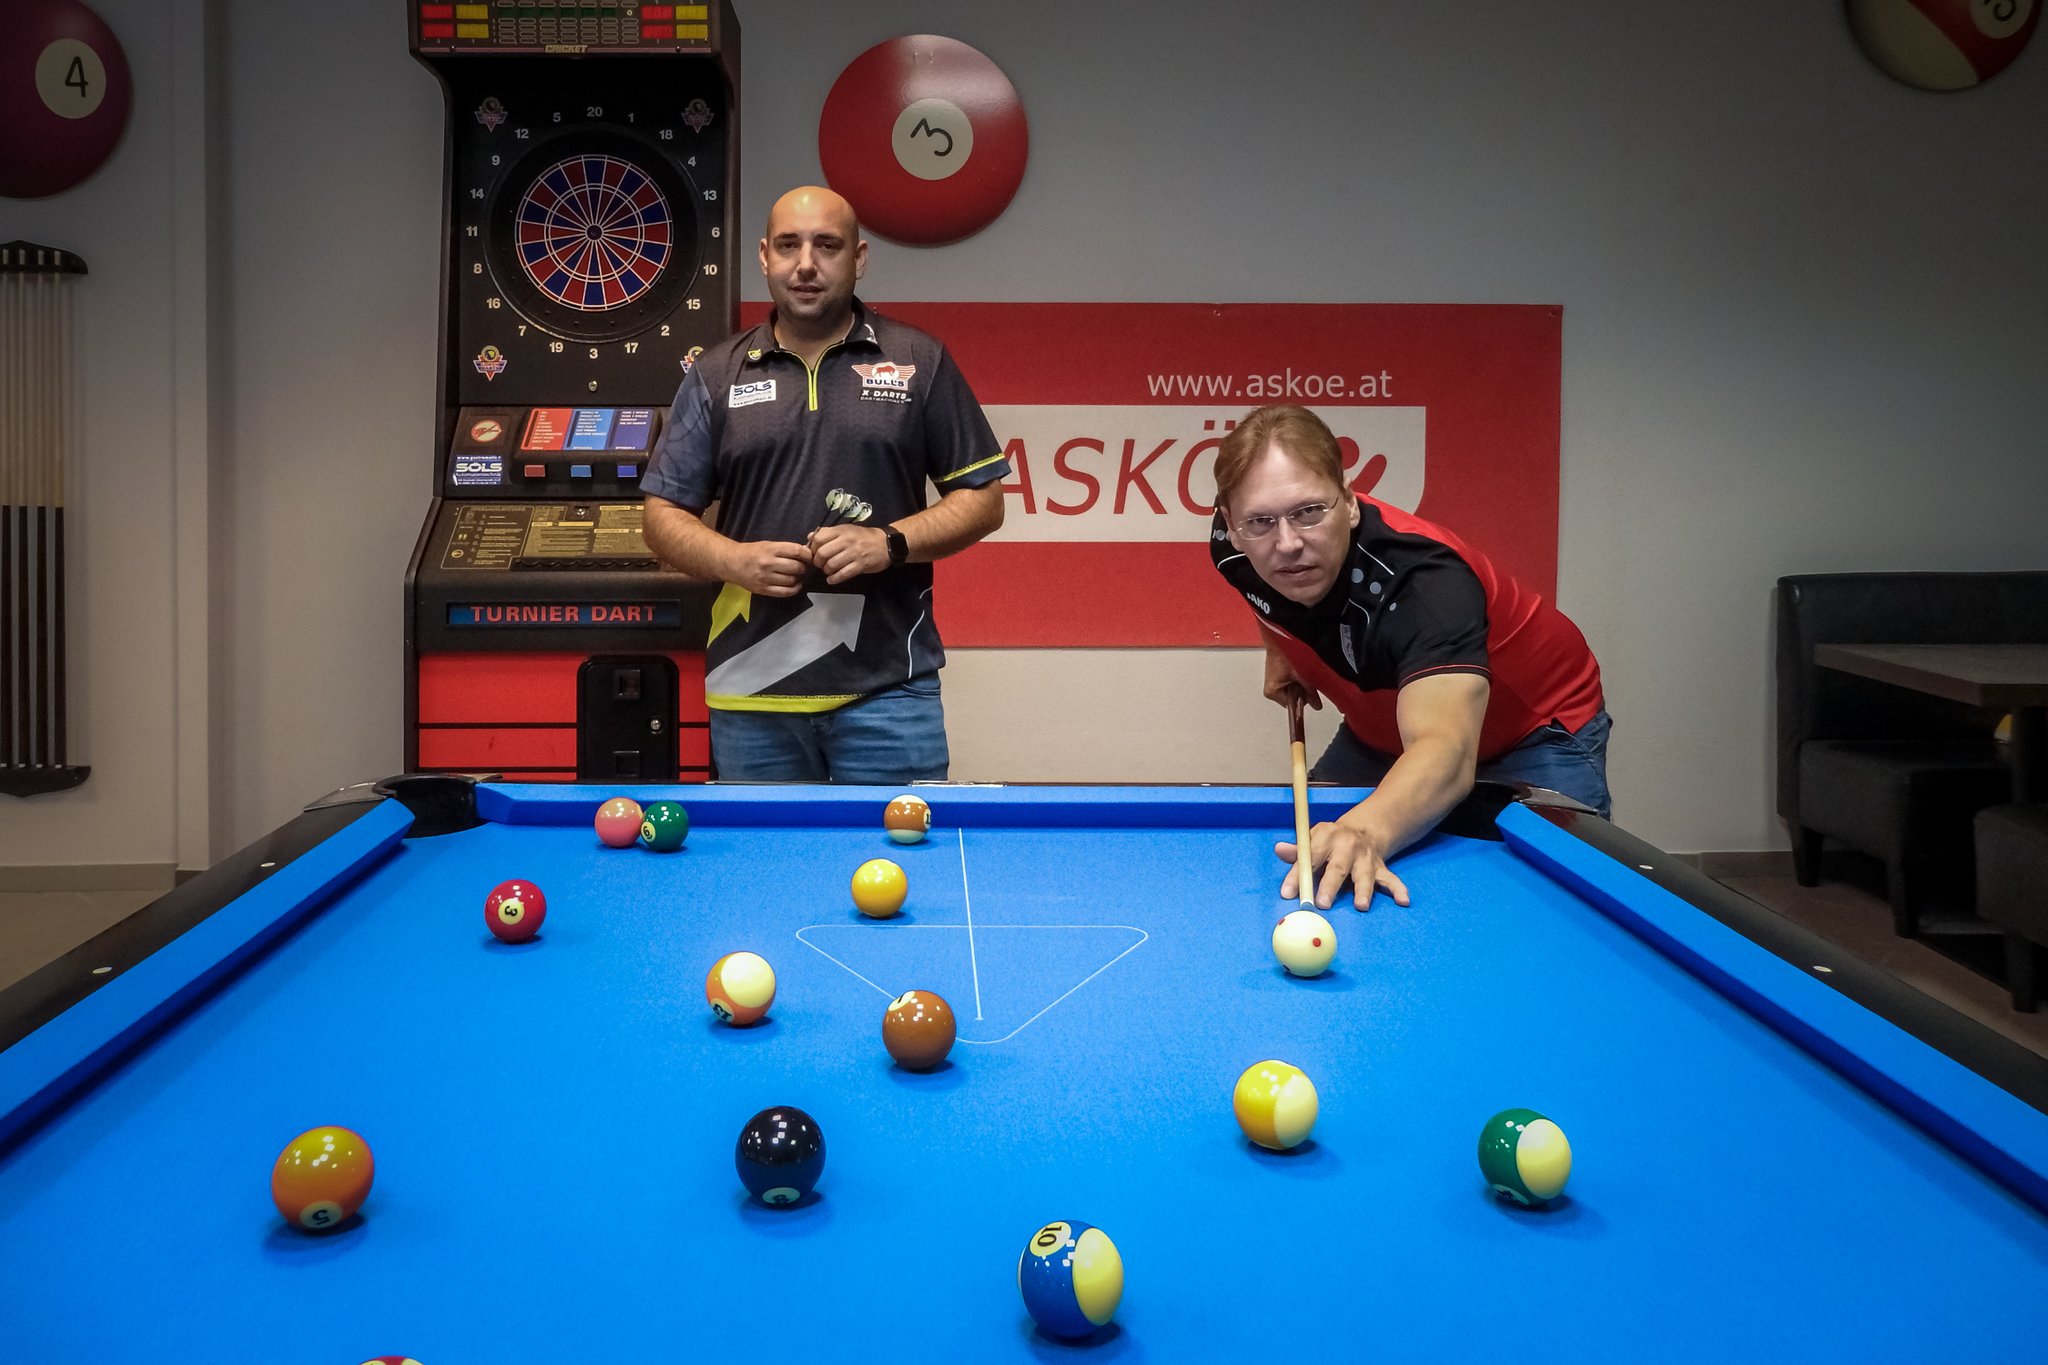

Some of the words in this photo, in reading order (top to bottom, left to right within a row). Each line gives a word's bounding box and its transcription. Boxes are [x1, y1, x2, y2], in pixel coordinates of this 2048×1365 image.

[64, 55, 89, 98] 4
[552, 112, 561, 123] 5
[586, 106, 603, 117] 20
[628, 112, 634, 123] 1
[514, 128, 529, 139] 12
[659, 129, 674, 140] 18
[910, 118, 953, 157] 3
[491, 154, 501, 166] 9
[687, 156, 697, 167] 4
[470, 188, 485, 199] 14
[703, 189, 717, 201] 13
[466, 225, 478, 237] 11
[711, 226, 721, 238] 6
[473, 262, 483, 274] 8
[703, 264, 718, 276] 10
[486, 297, 501, 309] 16
[686, 298, 701, 310] 15
[518, 325, 527, 337] 7
[660, 324, 670, 337] 2
[549, 341, 564, 353] 19
[624, 342, 639, 354] 17
[589, 348, 599, 359] 3
[866, 379, 905, 387] BULL'S
[1147, 367, 1393, 398] www.askoe.at
[873, 390, 907, 400] DARTS
[470, 605, 579, 623] TURNIER
[591, 605, 657, 623] DART
[504, 905, 518, 918] 3
[312, 1209, 330, 1225] 5
[1037, 1225, 1062, 1247] 10
